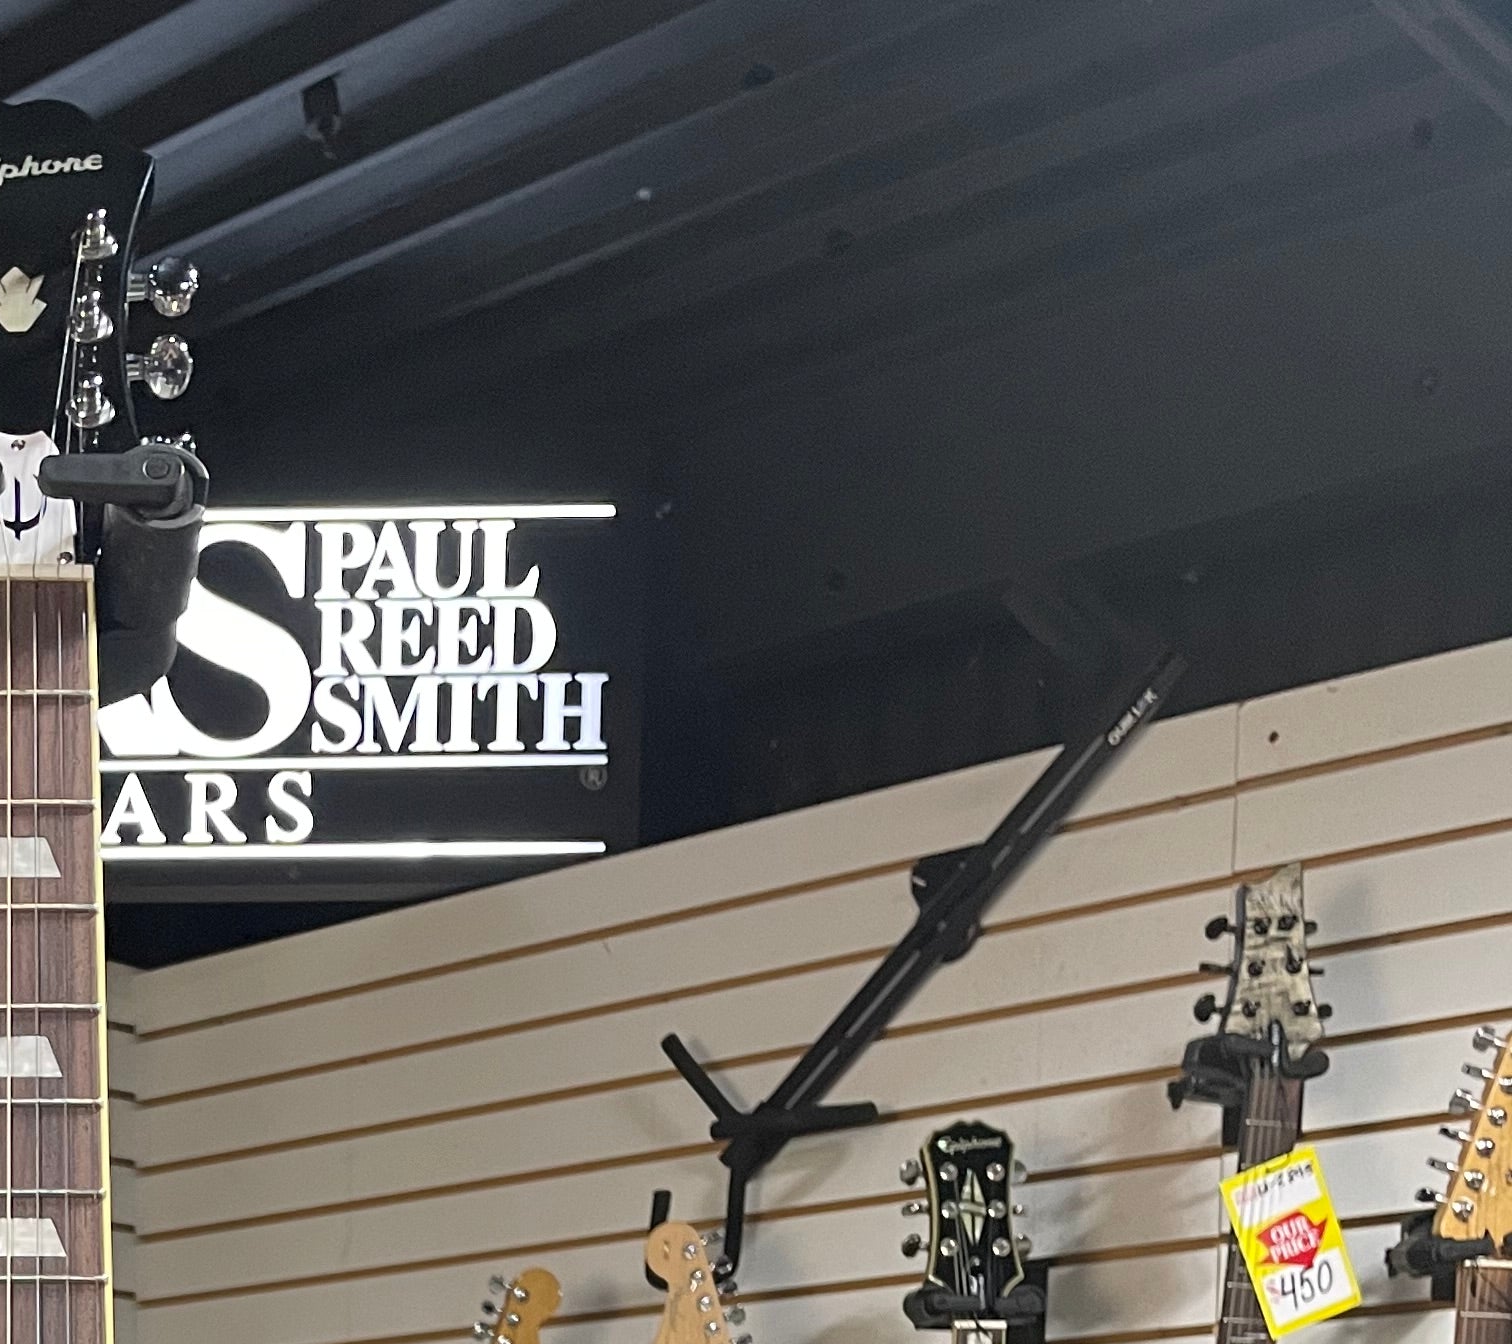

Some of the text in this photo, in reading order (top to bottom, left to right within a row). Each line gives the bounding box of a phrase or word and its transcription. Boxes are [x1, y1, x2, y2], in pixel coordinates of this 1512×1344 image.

[315, 520, 540, 600] PAUL
[315, 599, 557, 677] REED
[311, 673, 609, 755] SMITH
[1269, 1227, 1321, 1265] PRICE
[1270, 1214, 1311, 1243] OUR
